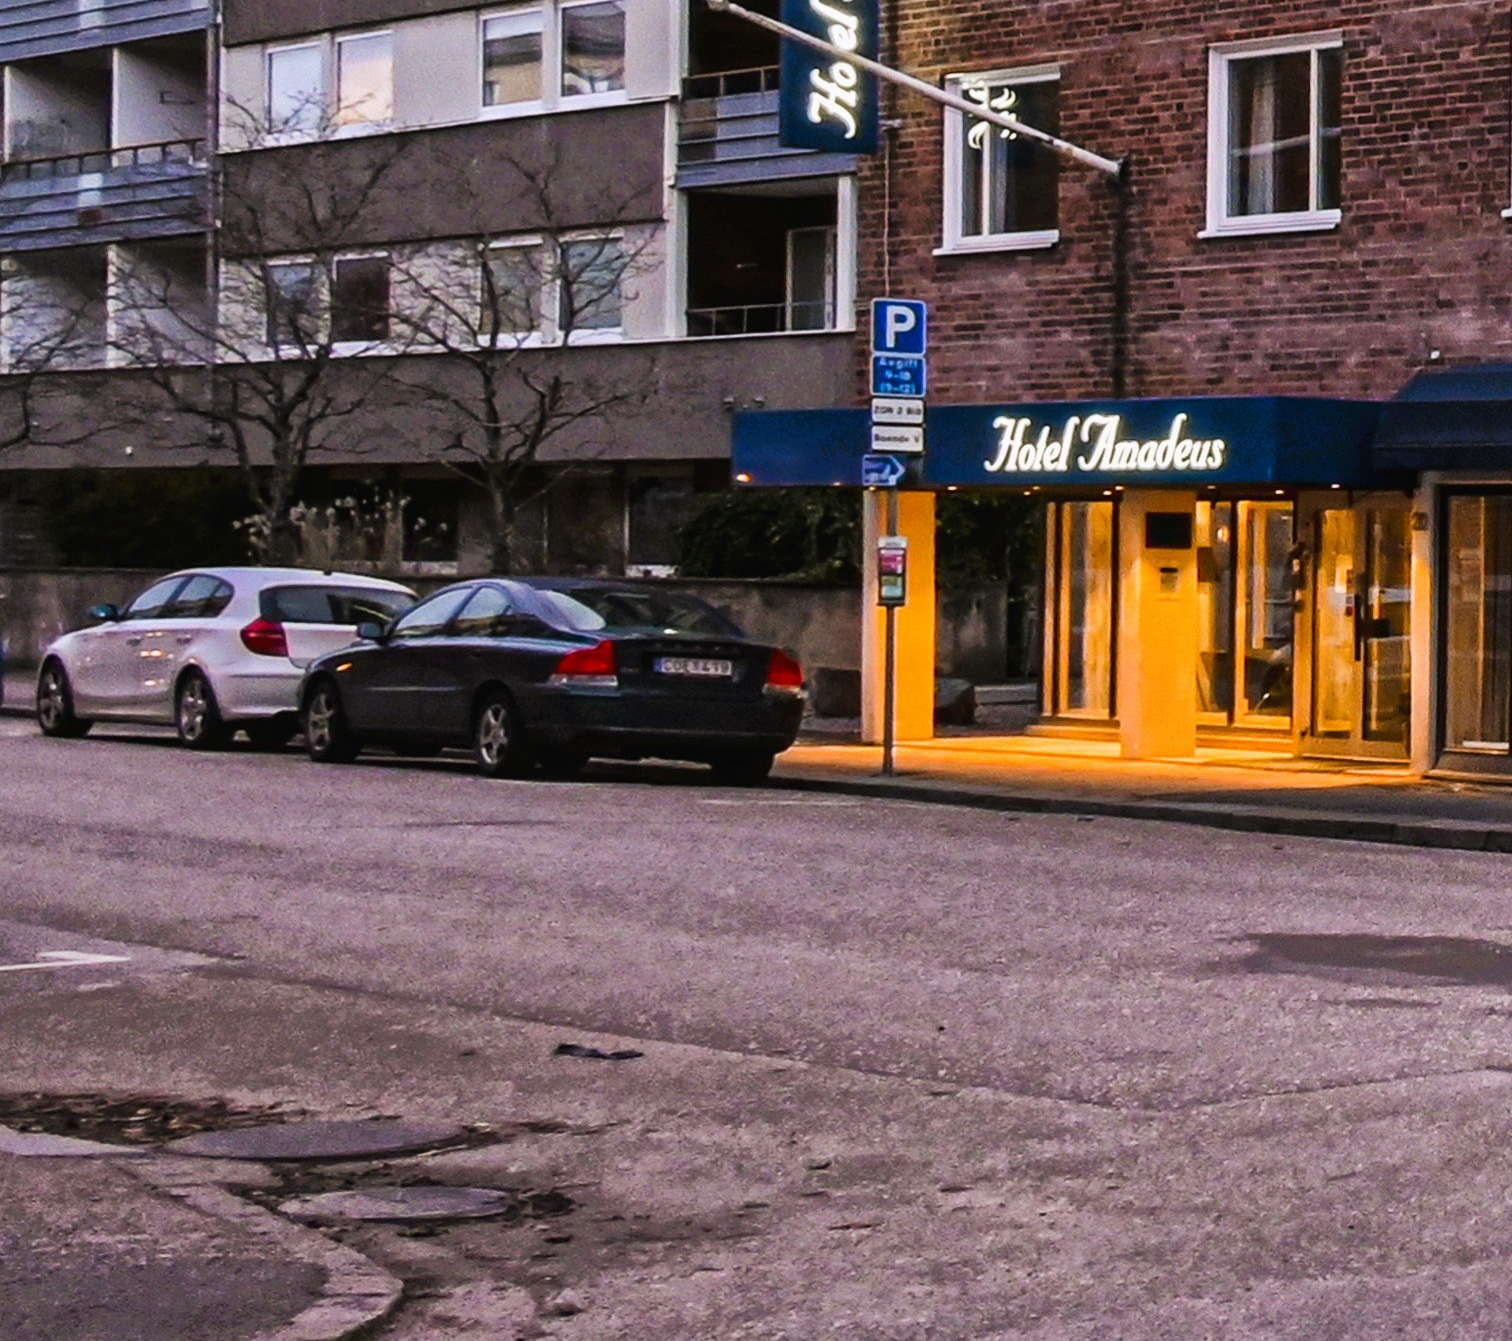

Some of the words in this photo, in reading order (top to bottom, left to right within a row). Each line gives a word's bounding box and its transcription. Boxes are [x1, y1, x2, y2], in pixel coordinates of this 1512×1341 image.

[885, 304, 916, 349] P
[984, 415, 1081, 472] Hotel
[1077, 412, 1225, 471] Amadeus
